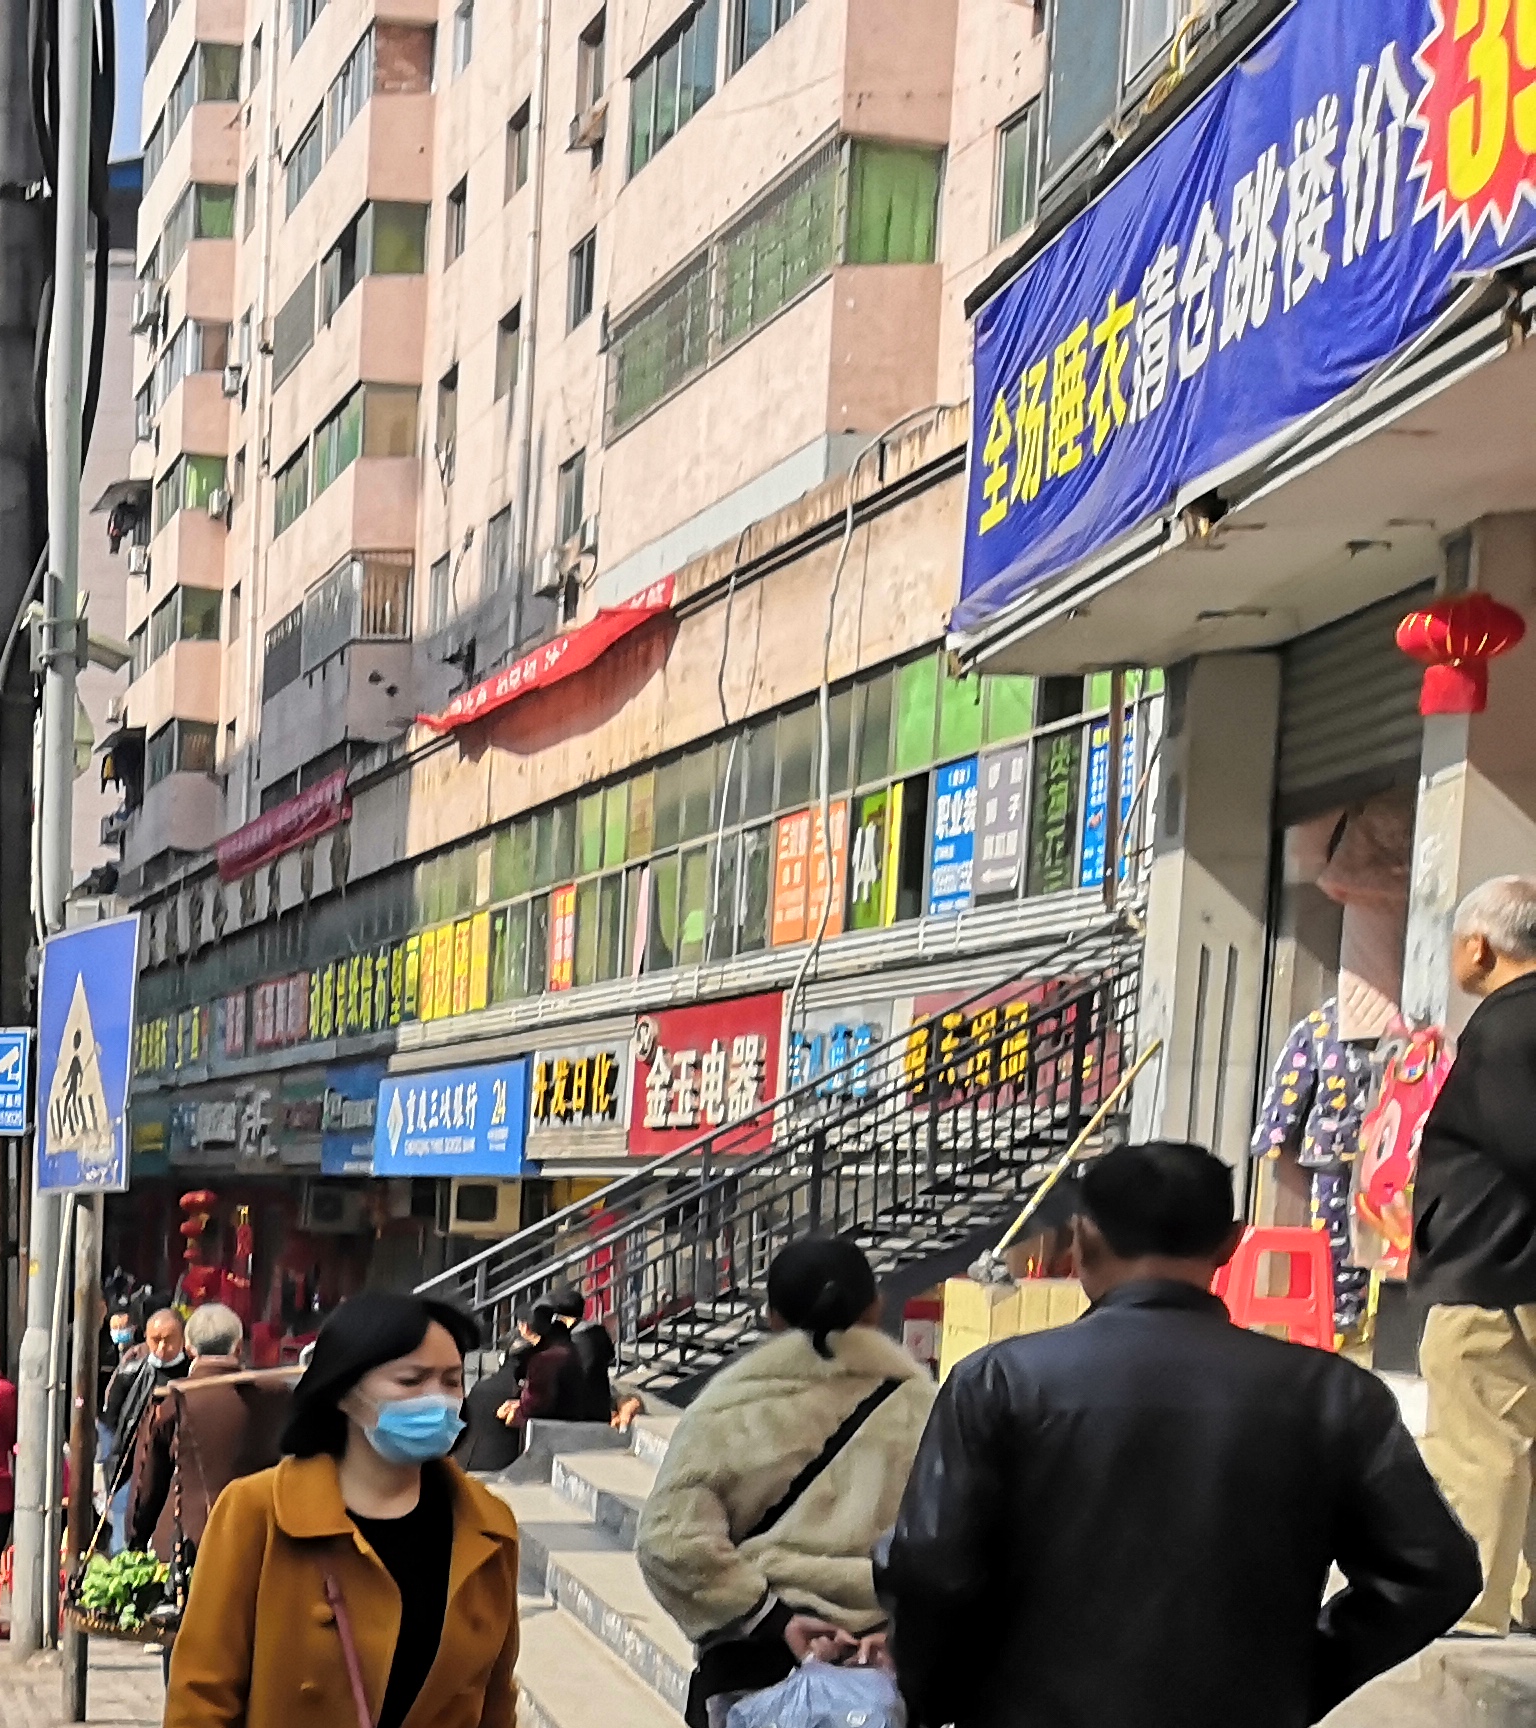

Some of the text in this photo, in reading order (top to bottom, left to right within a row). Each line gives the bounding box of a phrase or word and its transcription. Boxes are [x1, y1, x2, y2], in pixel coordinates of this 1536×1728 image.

[978, 40, 1411, 536] 全场睡衣清仓跳楼价
[644, 1034, 764, 1128] 金玉电器
